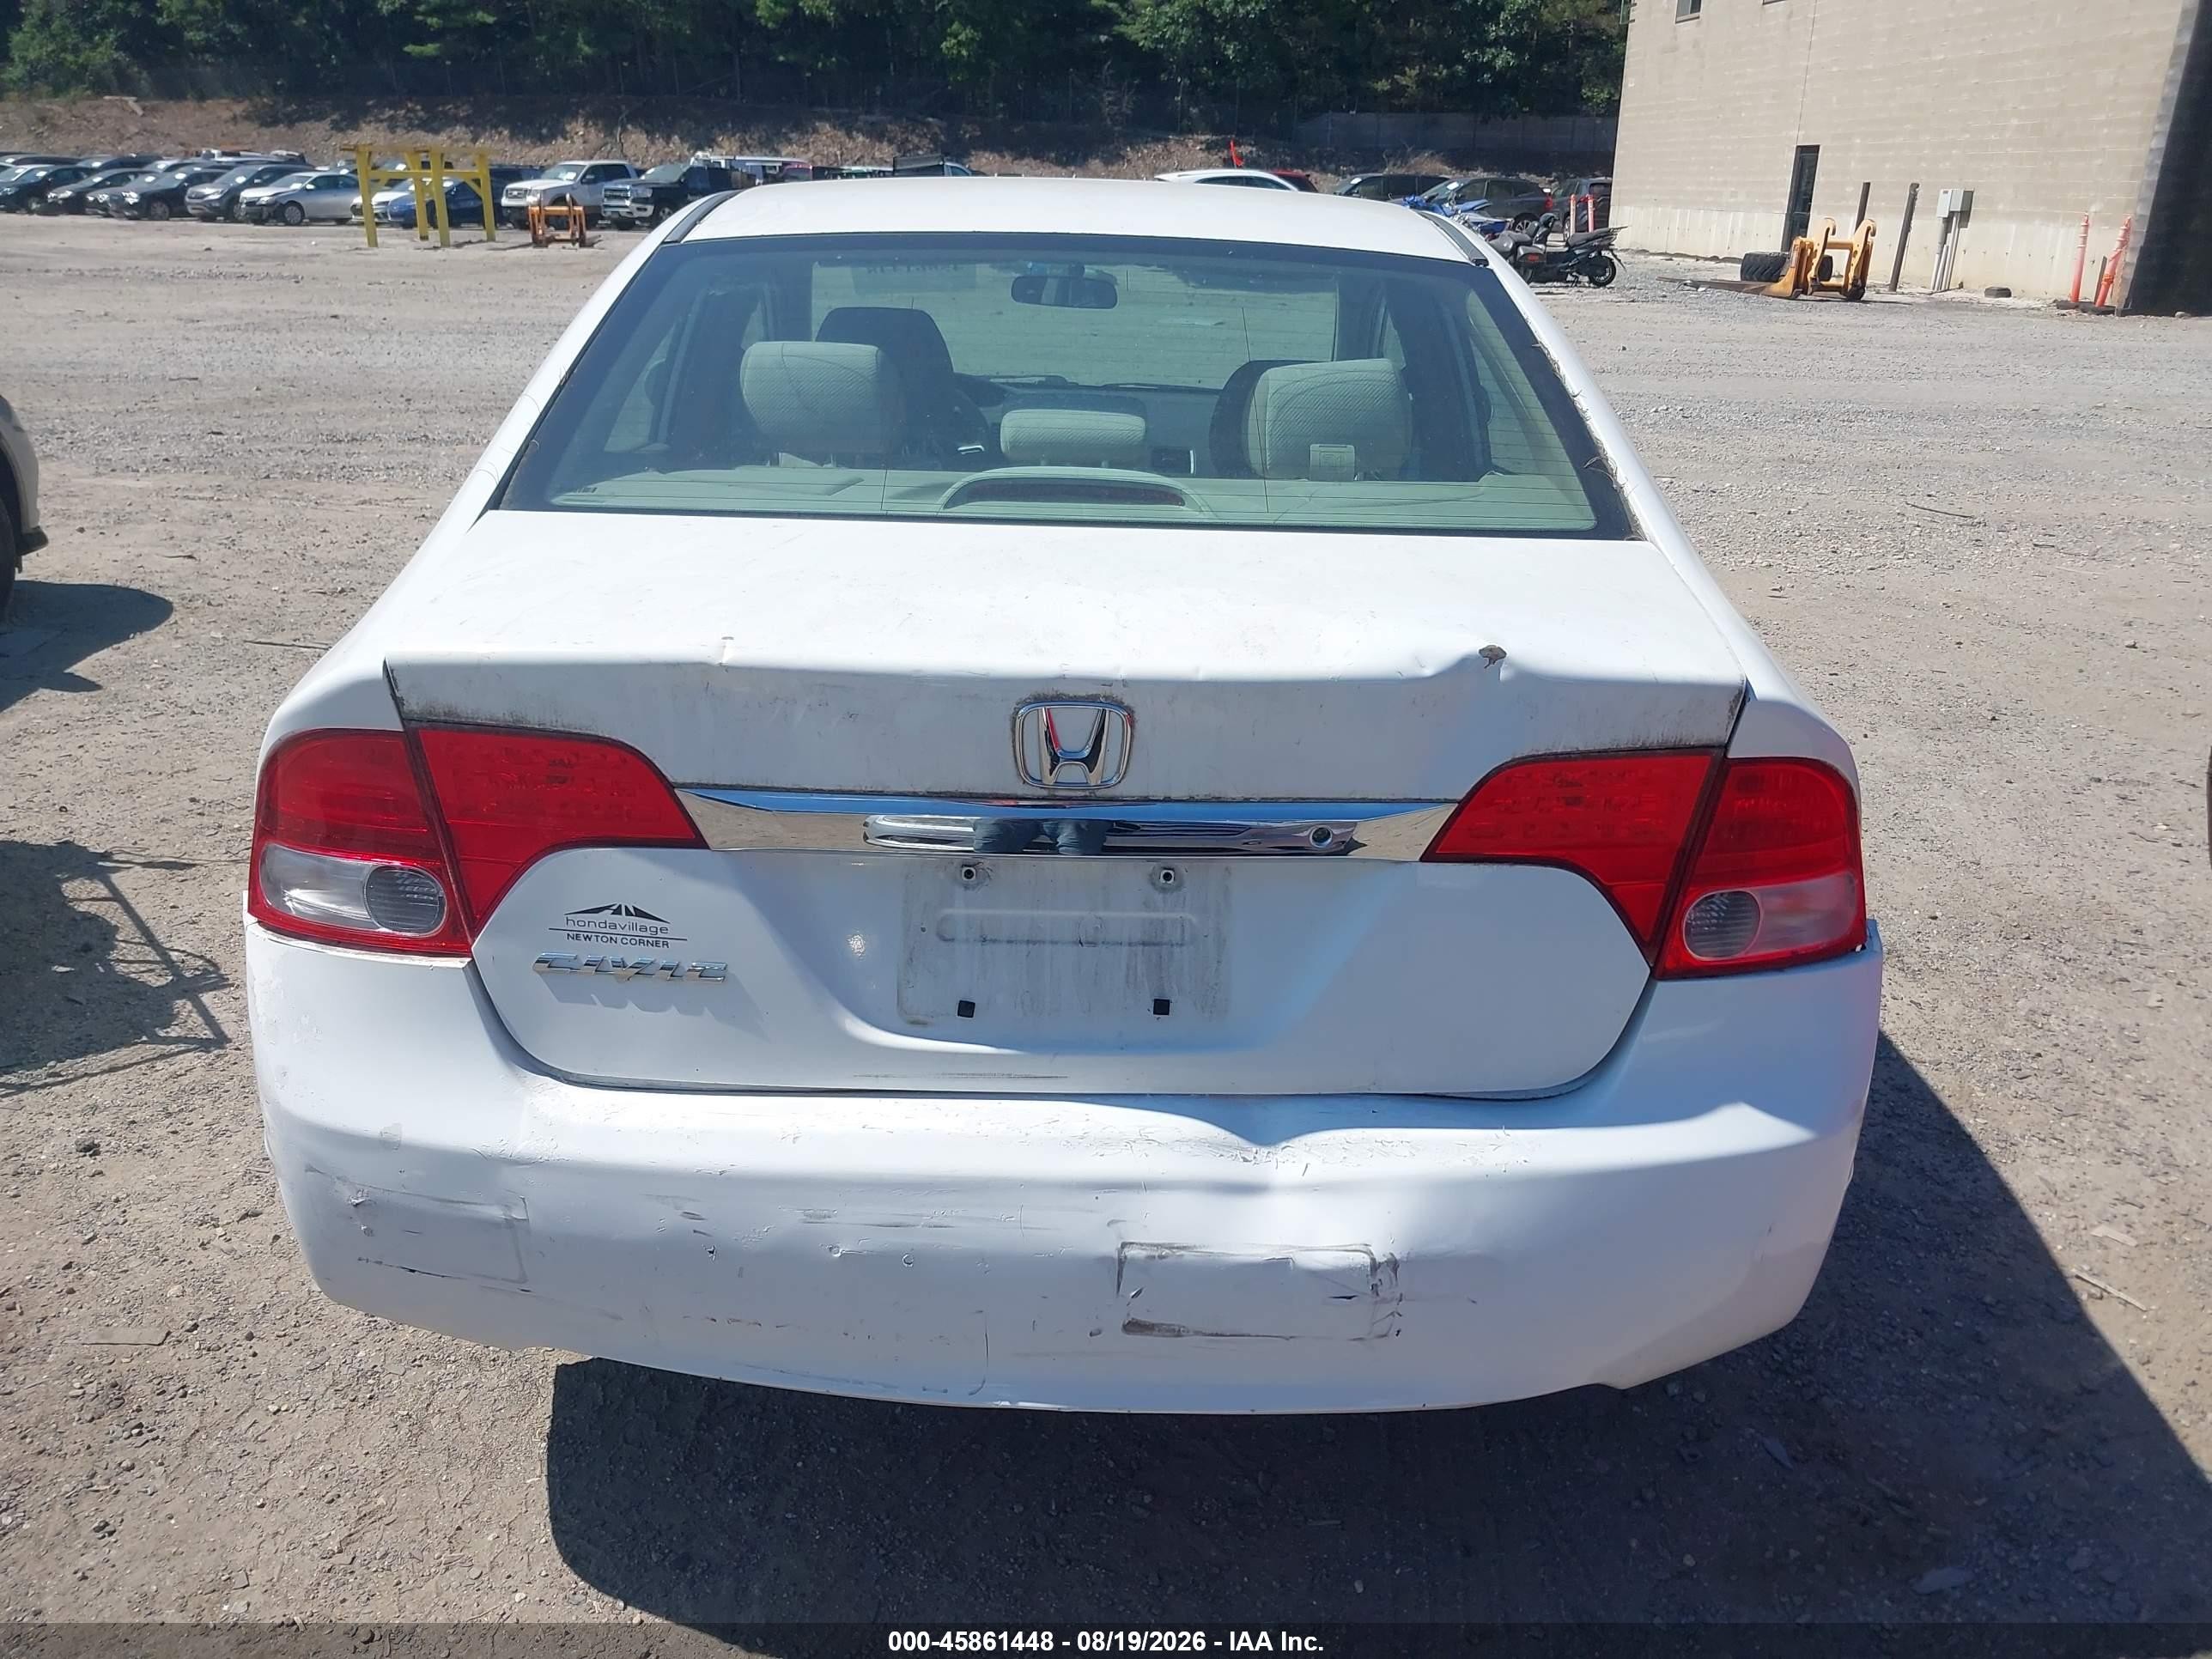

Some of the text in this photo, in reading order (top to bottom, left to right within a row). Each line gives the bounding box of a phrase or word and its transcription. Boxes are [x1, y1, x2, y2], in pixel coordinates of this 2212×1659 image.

[565, 916, 669, 936] hondavillage
[567, 933, 669, 949] NEWTON CORNER
[532, 951, 728, 983] CIVIC
